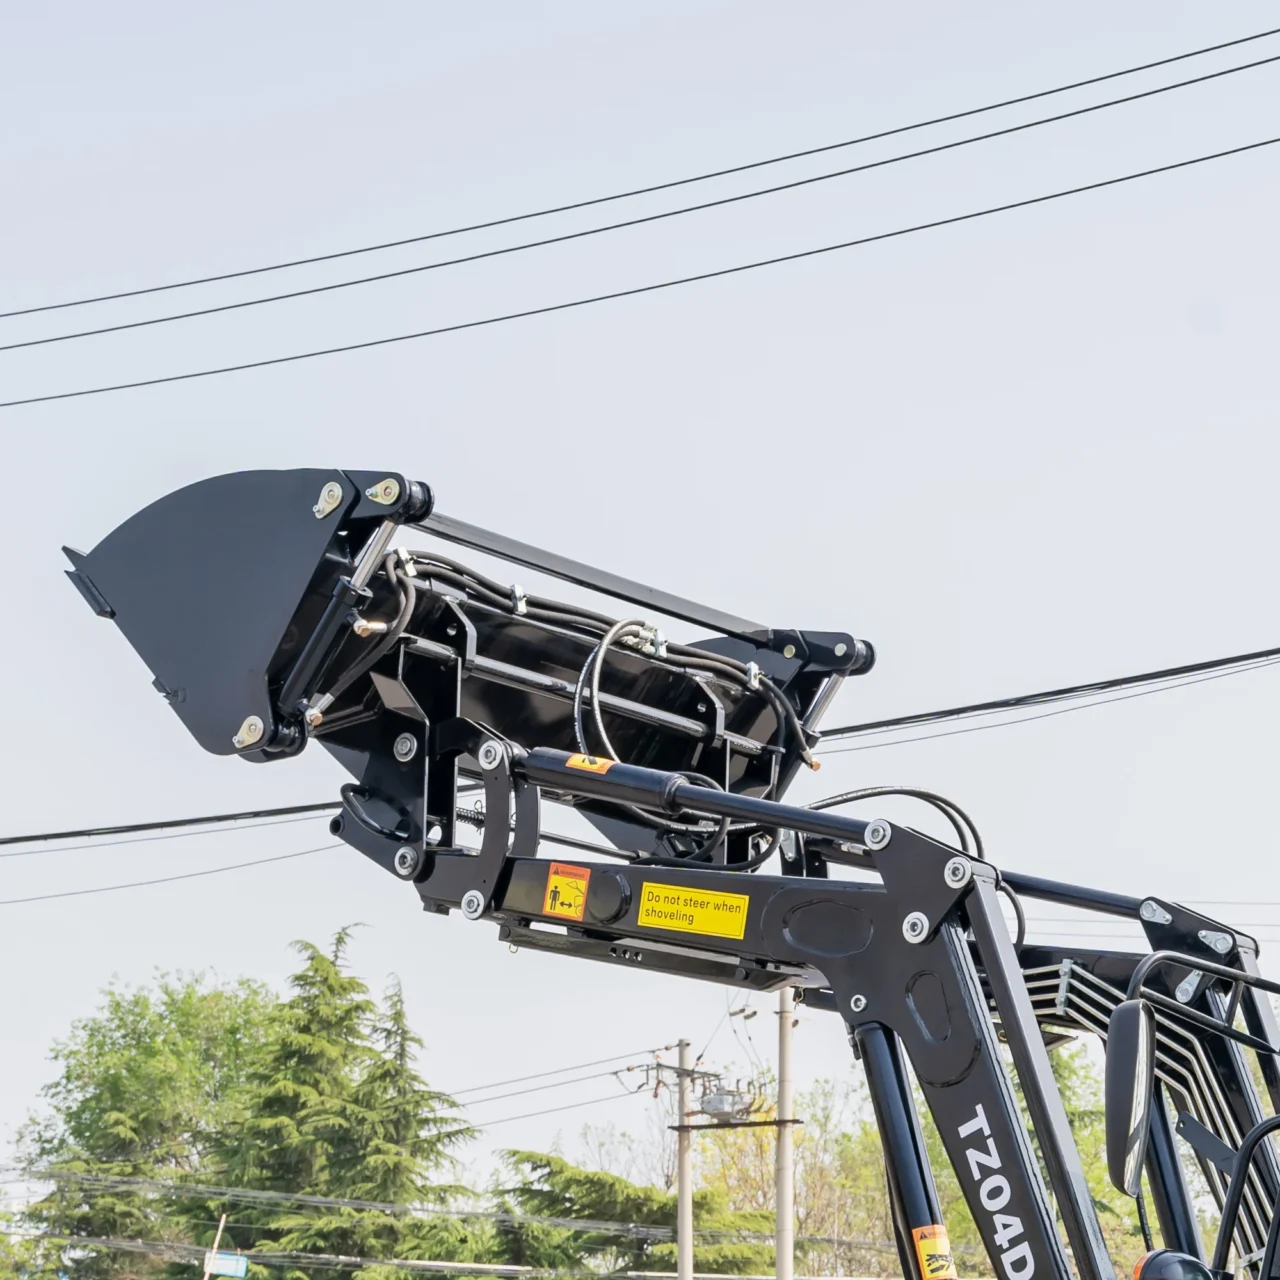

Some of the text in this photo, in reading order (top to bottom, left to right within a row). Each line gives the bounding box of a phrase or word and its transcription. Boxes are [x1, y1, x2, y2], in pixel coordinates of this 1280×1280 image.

[646, 891, 742, 913] Do not steer when
[644, 907, 695, 926] shoveling
